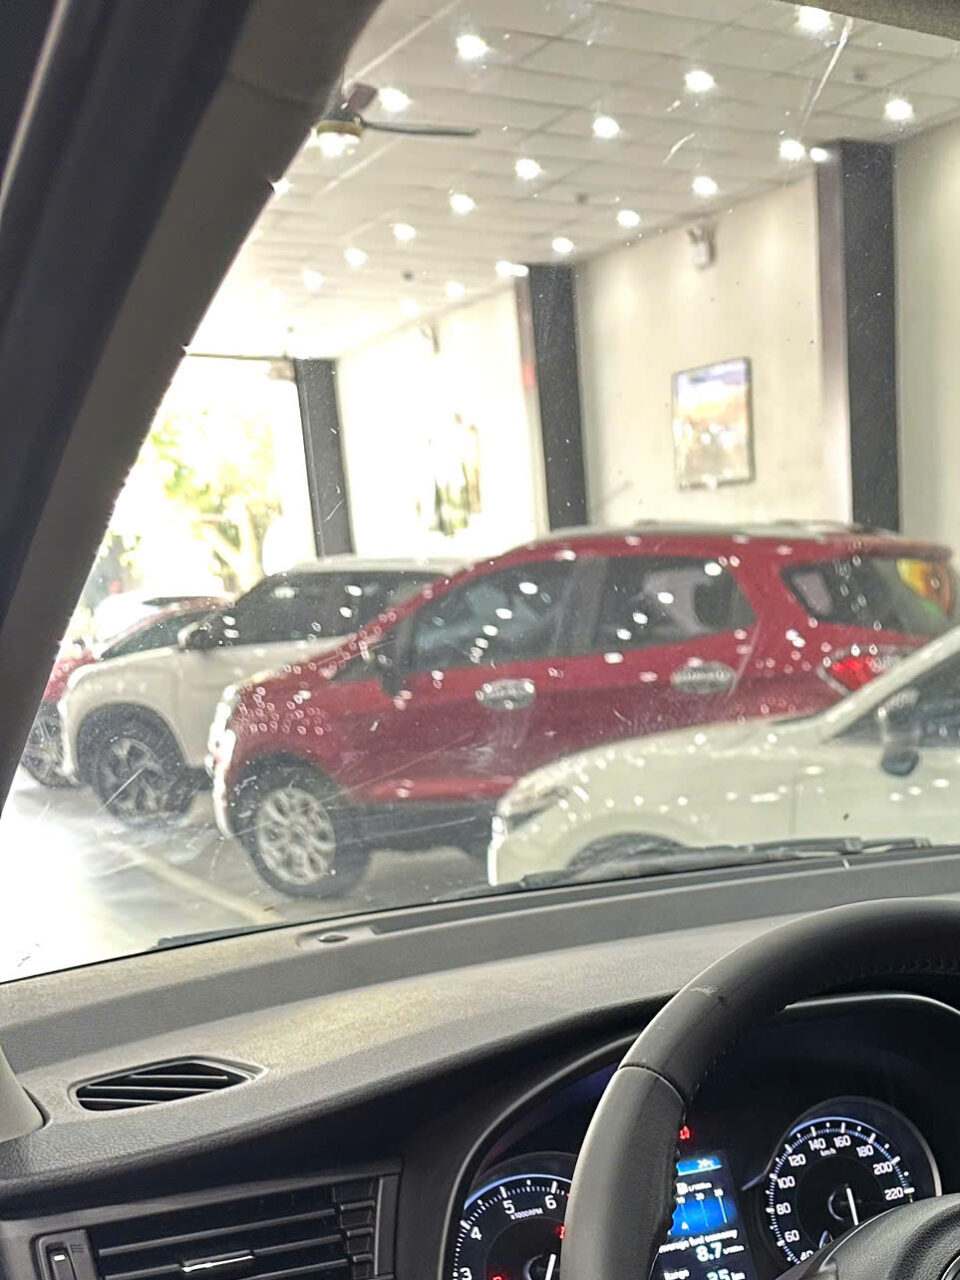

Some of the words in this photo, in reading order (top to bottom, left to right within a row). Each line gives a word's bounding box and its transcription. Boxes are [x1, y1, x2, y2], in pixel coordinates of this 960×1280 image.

[808, 1138, 826, 1151] 140
[833, 1135, 851, 1148] 160
[856, 1145, 874, 1157] 180
[788, 1153, 806, 1166] 120
[873, 1162, 893, 1175] 200
[777, 1176, 795, 1189] 100
[884, 1188, 904, 1201] 220
[503, 1200, 515, 1215] 5
[545, 1195, 557, 1210] 6
[776, 1203, 791, 1215] 80
[471, 1226, 482, 1241] 4
[784, 1230, 800, 1243] 60
[696, 1241, 722, 1262] 8.7
